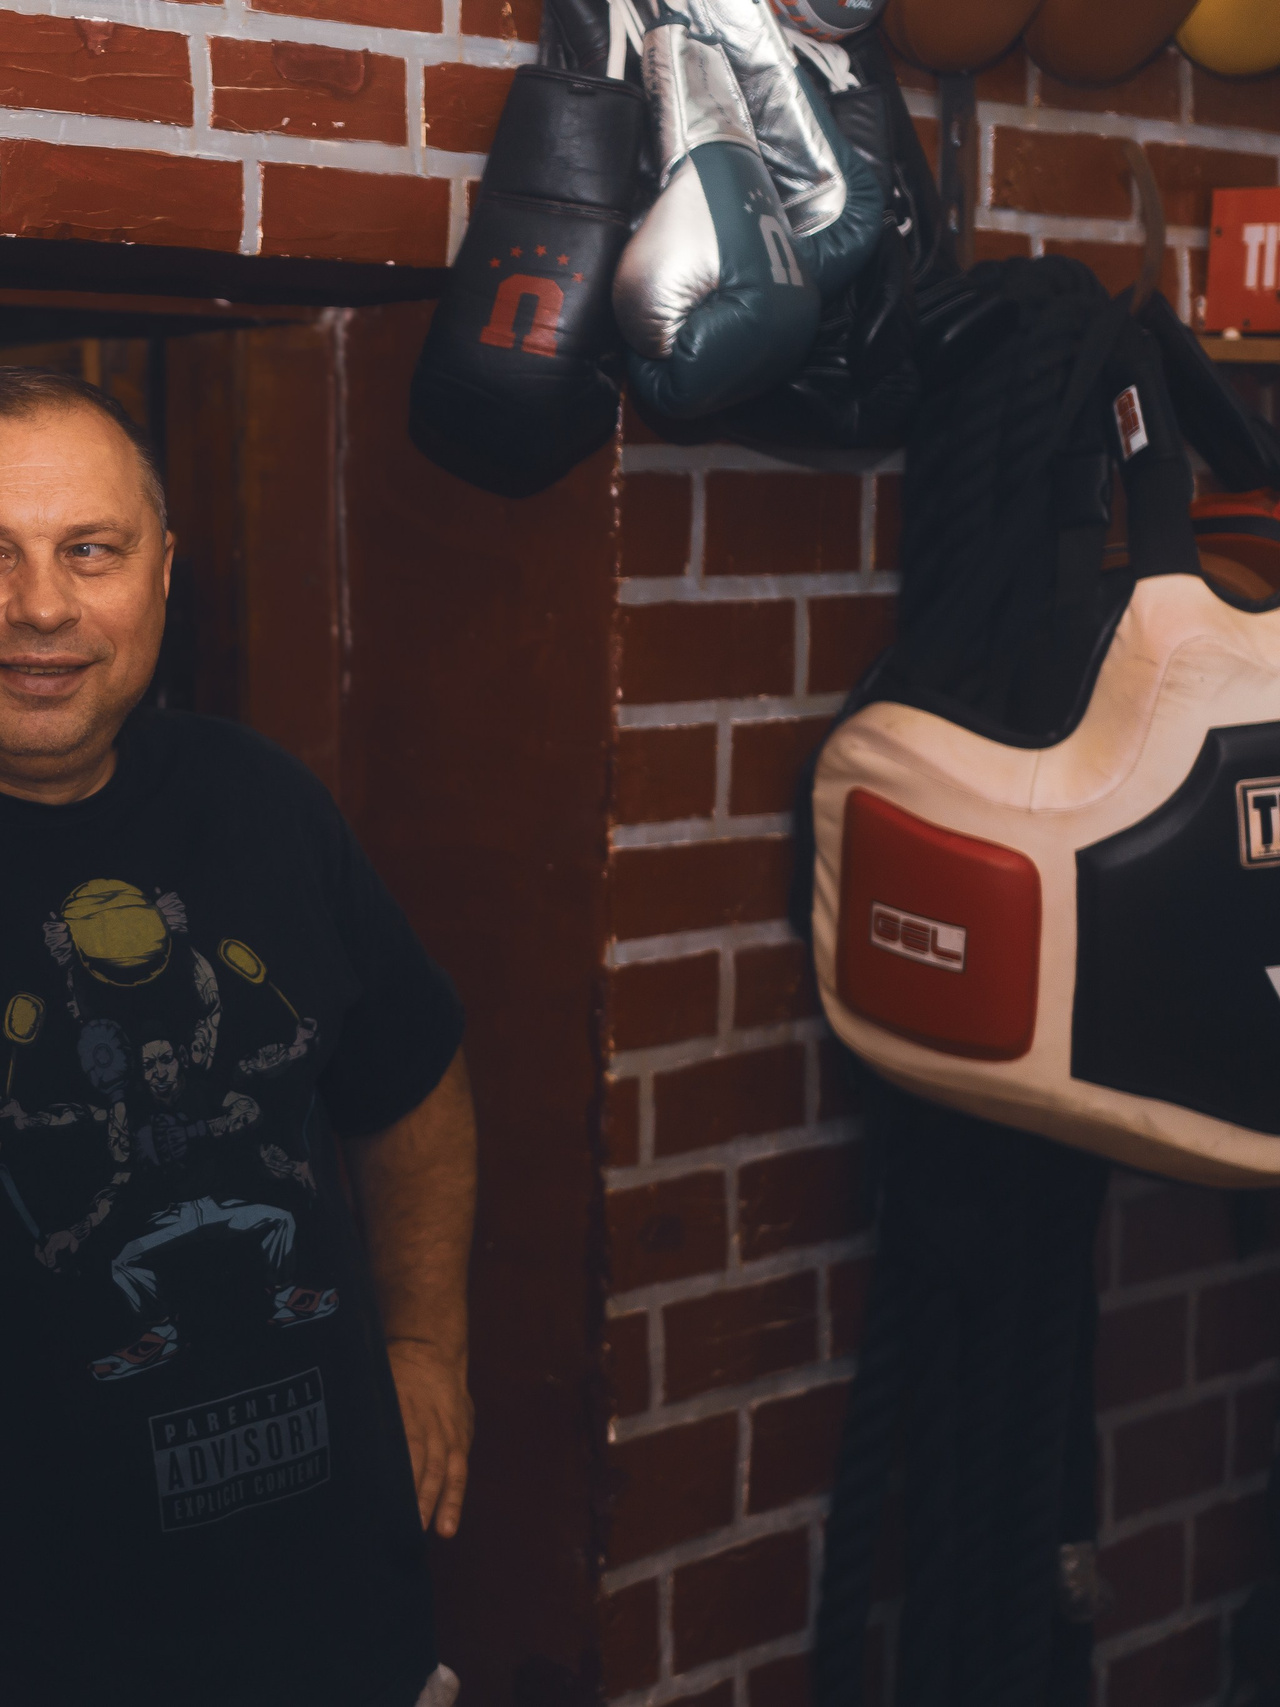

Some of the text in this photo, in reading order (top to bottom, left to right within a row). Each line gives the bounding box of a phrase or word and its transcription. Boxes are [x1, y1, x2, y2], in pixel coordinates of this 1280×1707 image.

[1243, 222, 1280, 291] TI
[873, 911, 962, 960] GEL
[164, 1382, 314, 1443] PARENTAL
[167, 1405, 319, 1491] ADVISORY
[174, 1455, 321, 1519] EXPLICIT CONTENT
